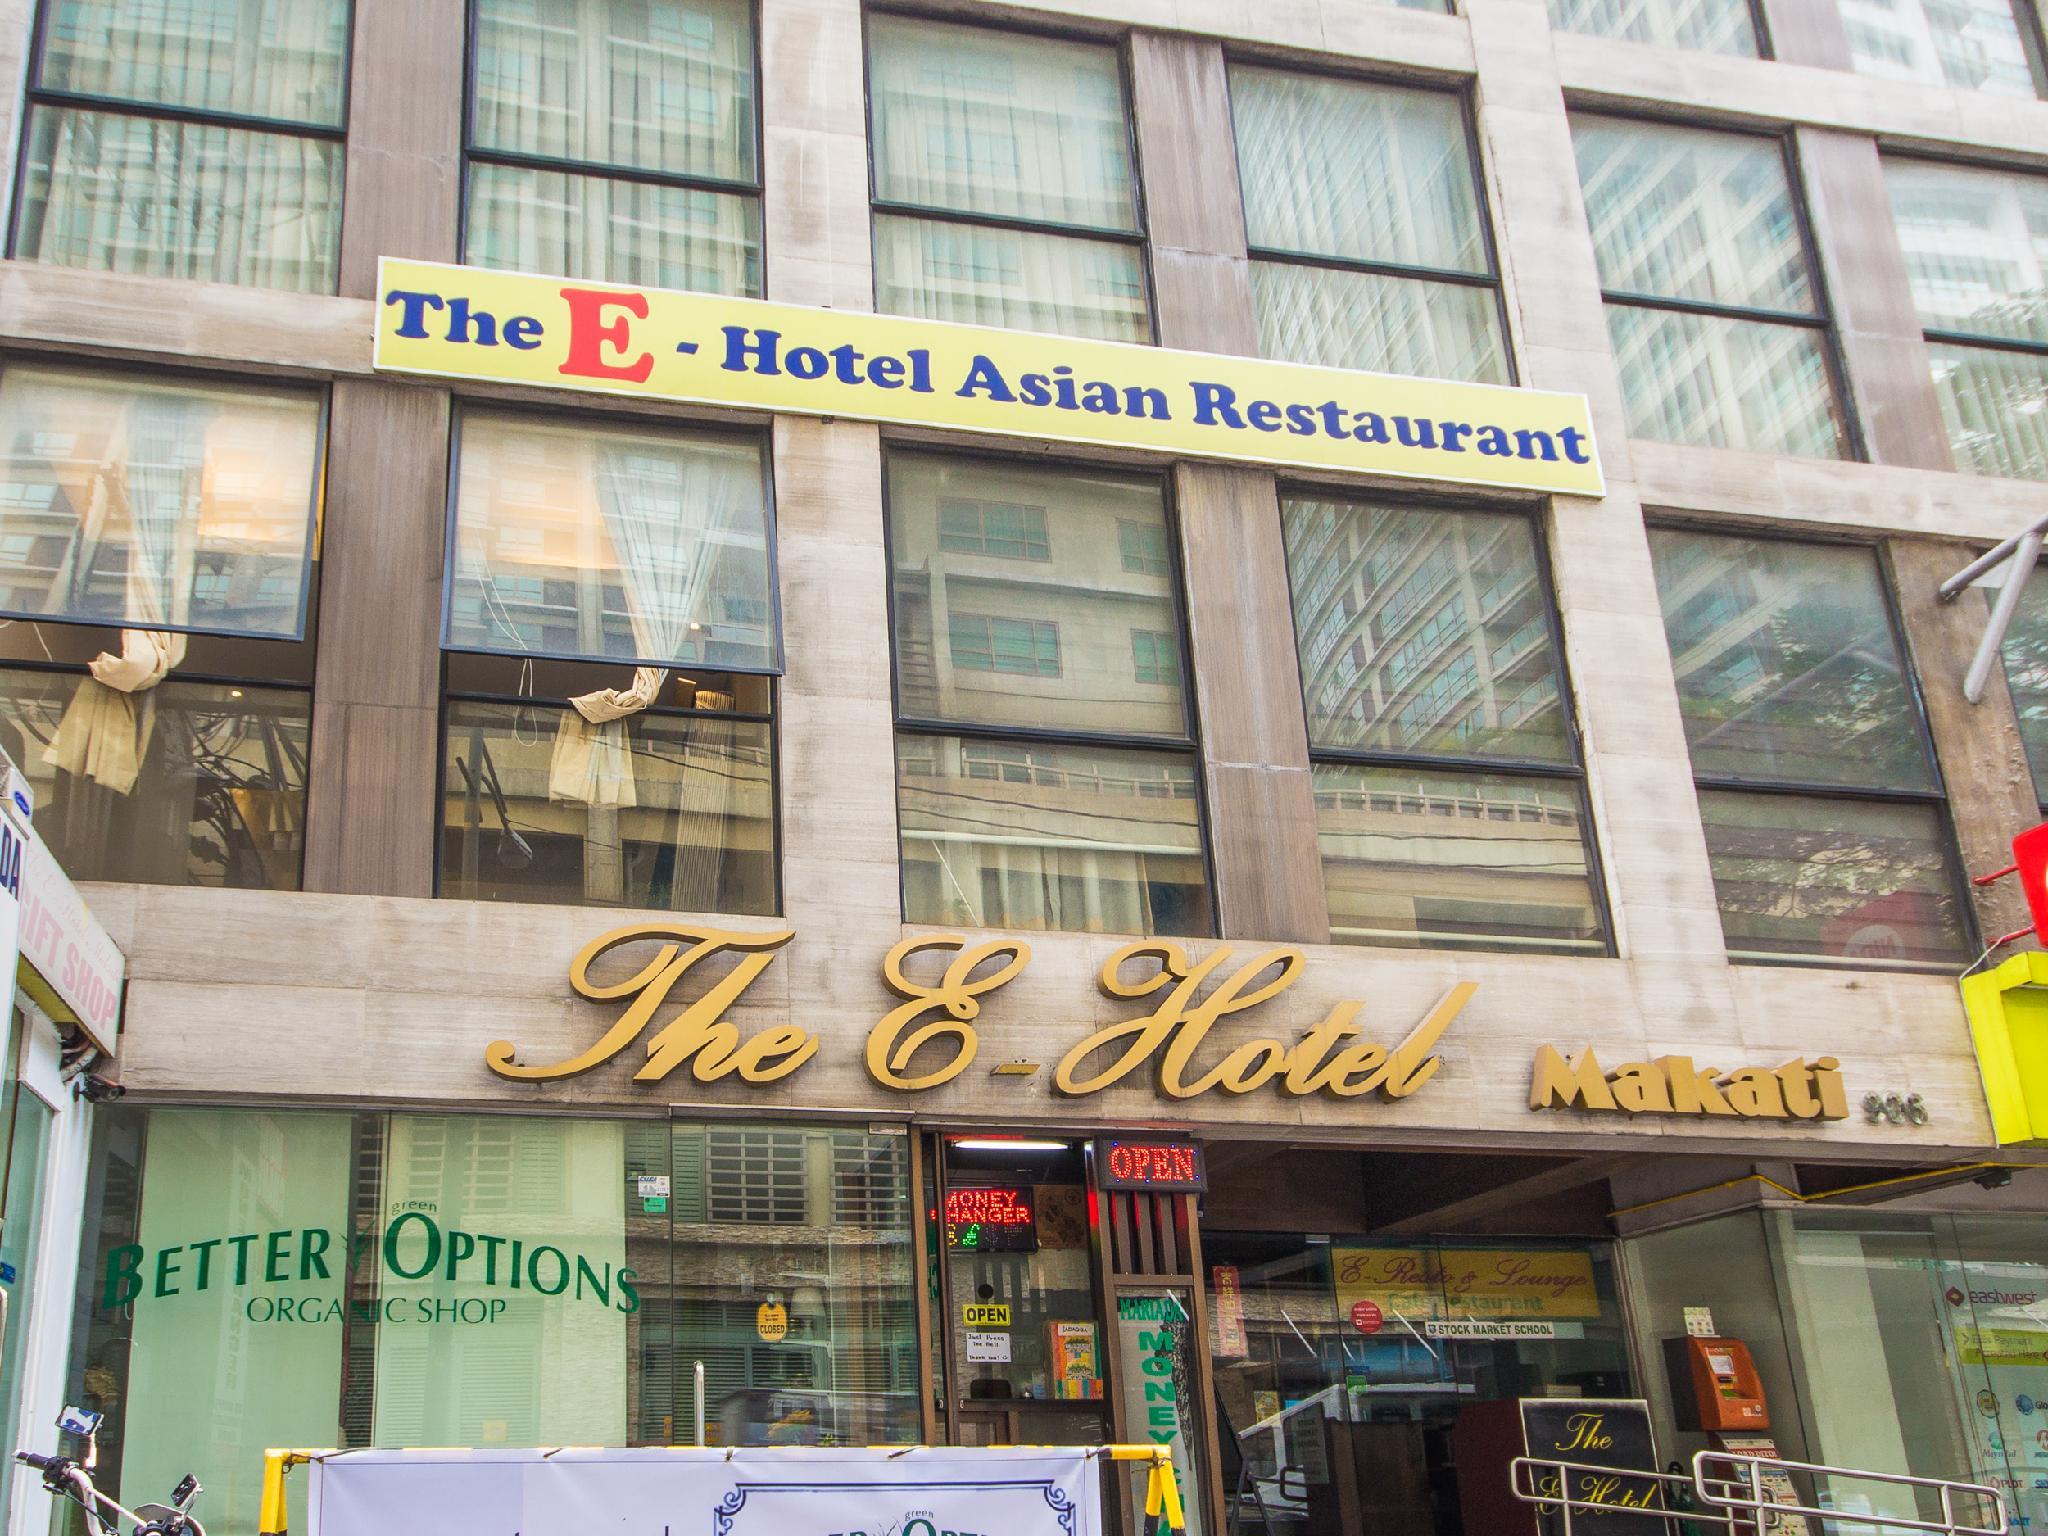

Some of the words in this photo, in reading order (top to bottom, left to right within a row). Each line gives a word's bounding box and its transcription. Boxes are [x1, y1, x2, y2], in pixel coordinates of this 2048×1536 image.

[385, 290, 544, 350] The
[558, 287, 655, 384] E
[720, 325, 936, 394] Hotel
[955, 355, 1172, 421] Asian
[1189, 380, 1591, 465] Restaurant
[61, 942, 117, 1031] SHOP
[485, 923, 819, 1087] The
[863, 934, 1032, 1094] E
[1050, 939, 1481, 1105] Hotel
[1529, 1043, 1850, 1123] Makati
[1109, 1147, 1195, 1182] OPEN
[391, 1200, 437, 1216] green
[102, 1229, 331, 1310] BETTER
[384, 1211, 641, 1313] OPTIONS
[1488, 1258, 1588, 1298] Lounge
[247, 1297, 406, 1324] ORGANIC
[417, 1297, 506, 1324] SHOP
[966, 1307, 1008, 1322] OPEN
[1968, 1288, 2038, 1306] eastwest
[760, 1324, 786, 1334] CLOSED
[1438, 1324, 1471, 1335] STOCK
[1472, 1324, 1512, 1335] MARKET
[1514, 1324, 1553, 1335] SCHOOL
[1137, 1331, 1178, 1446] MONEY
[1554, 1413, 1613, 1451] The
[904, 1510, 934, 1521] green
